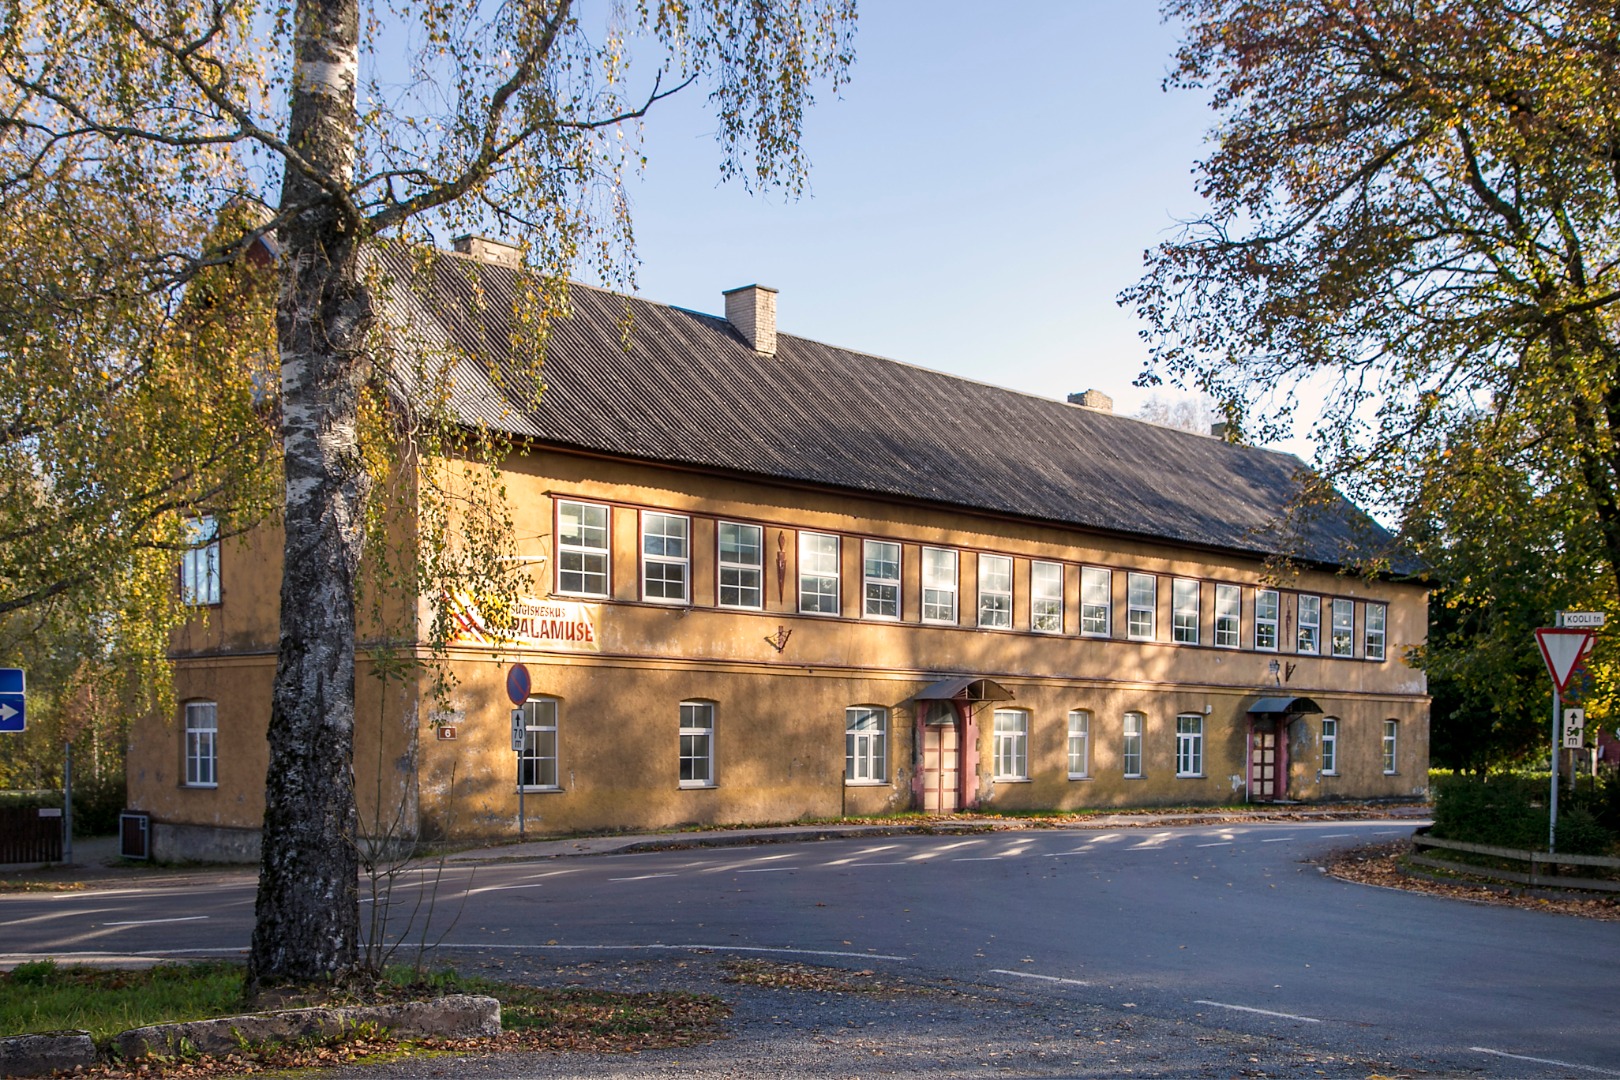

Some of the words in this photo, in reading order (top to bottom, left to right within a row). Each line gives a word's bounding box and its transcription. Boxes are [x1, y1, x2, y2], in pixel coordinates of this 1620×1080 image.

[1567, 615, 1591, 623] KOOLI
[1593, 615, 1602, 623] tn
[511, 617, 594, 642] PALAMUSE
[444, 728, 451, 738] 6
[513, 728, 523, 739] 70
[1566, 726, 1580, 737] 5
[514, 740, 522, 748] m
[1568, 737, 1578, 746] m
